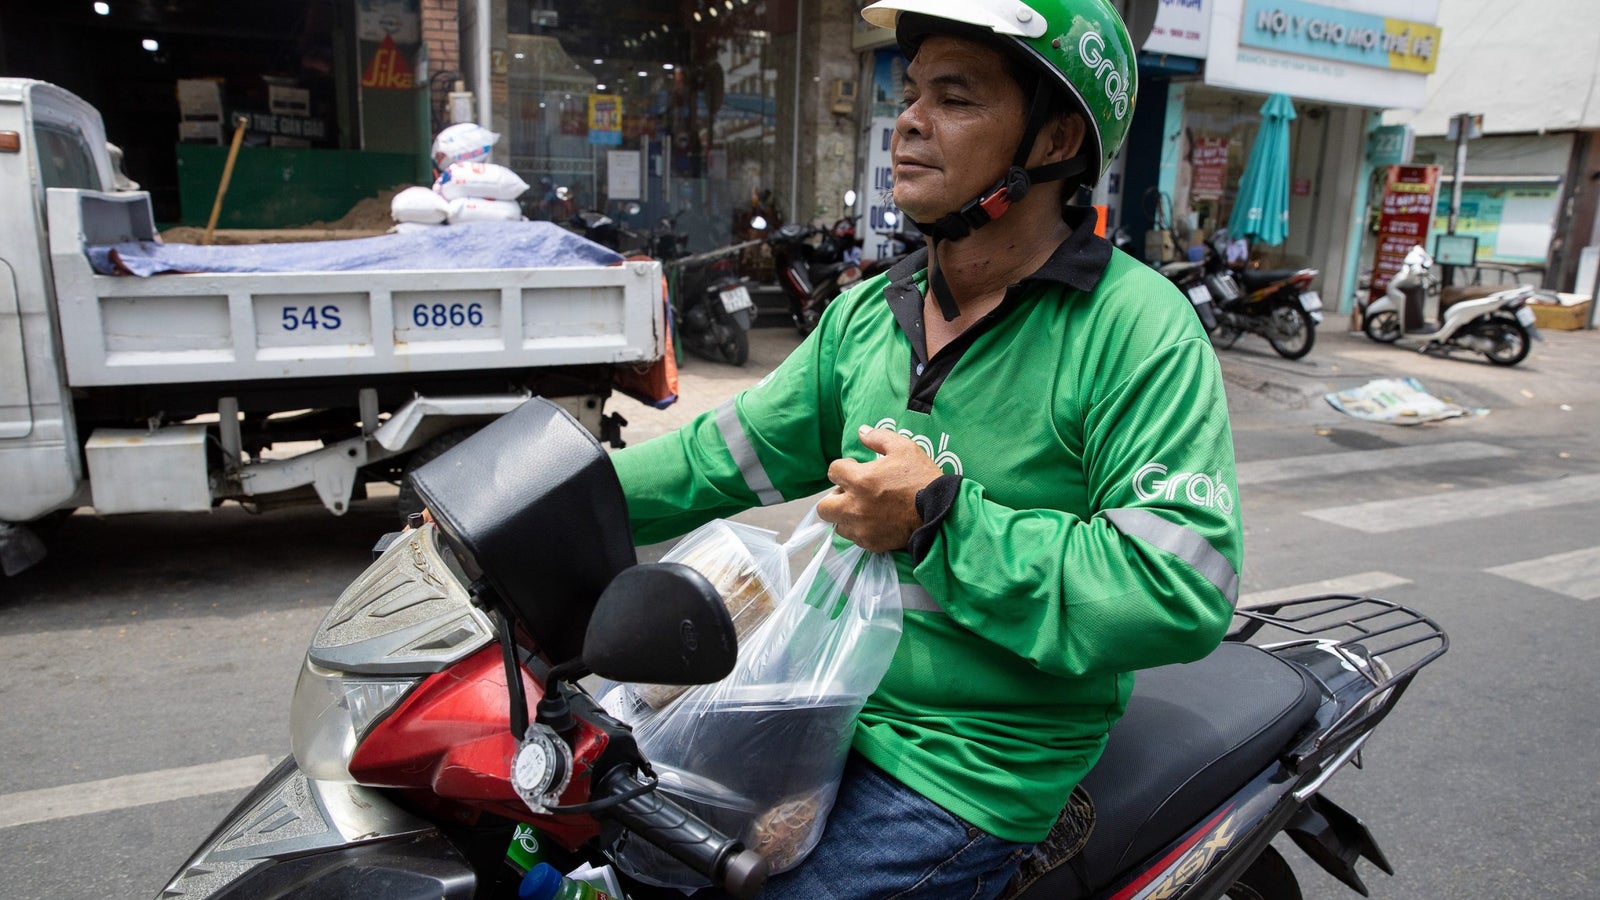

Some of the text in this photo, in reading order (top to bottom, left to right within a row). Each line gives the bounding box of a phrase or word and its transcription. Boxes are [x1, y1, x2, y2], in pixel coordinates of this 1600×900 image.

[1258, 10, 1290, 38] NỘI
[1293, 16, 1305, 36] Y
[1307, 20, 1344, 44] CHO
[1346, 27, 1379, 52] MỌI
[361, 48, 414, 89] Sika
[1079, 31, 1129, 120] Grab
[231, 111, 252, 128] CO
[281, 302, 483, 331] 54S 6866
[1132, 463, 1234, 515] Grab
[1144, 814, 1236, 900] RSX
